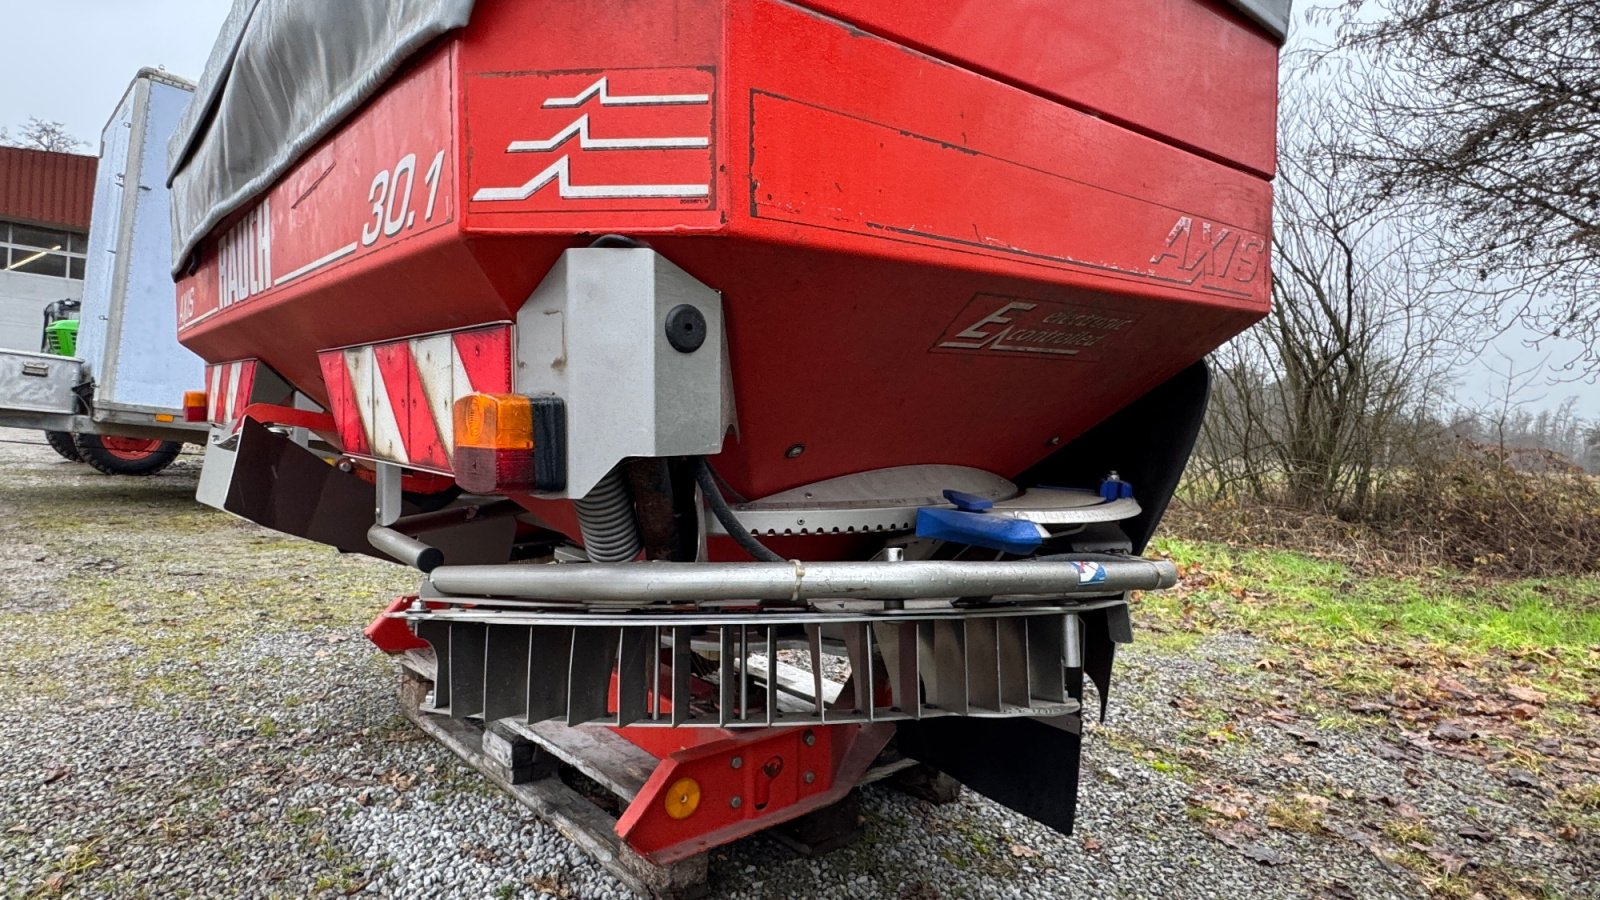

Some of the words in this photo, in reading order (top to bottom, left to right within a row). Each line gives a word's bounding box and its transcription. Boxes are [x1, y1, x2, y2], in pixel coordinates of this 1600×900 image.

[361, 149, 446, 246] 30.1
[1150, 215, 1266, 284] AXIS
[1007, 328, 1104, 346] controlled
